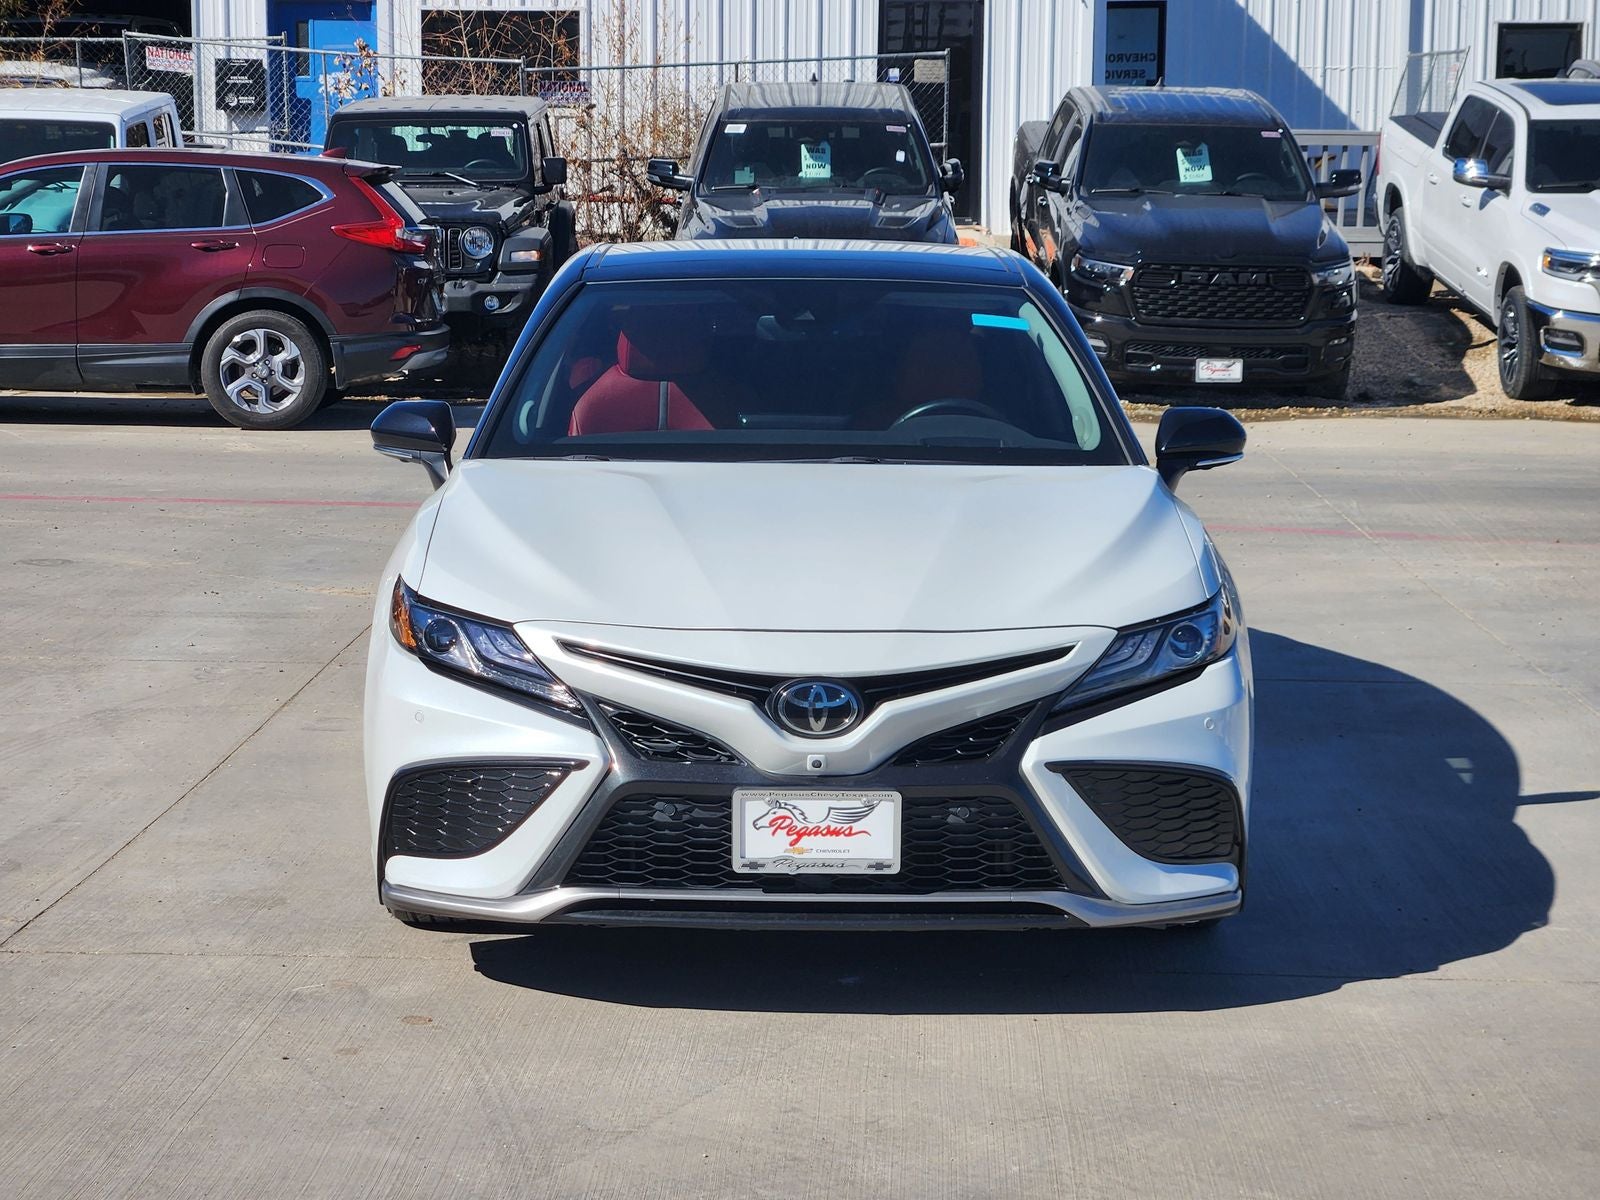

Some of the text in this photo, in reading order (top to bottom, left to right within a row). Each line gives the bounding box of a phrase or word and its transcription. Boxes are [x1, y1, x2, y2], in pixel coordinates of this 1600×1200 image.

[147, 47, 192, 61] NATIONAL
[540, 81, 589, 93] NATIONAL
[806, 162, 826, 170] NOW
[1182, 271, 1267, 285] RAM
[768, 815, 872, 847] Pegasus
[773, 858, 862, 873] Pegasus
